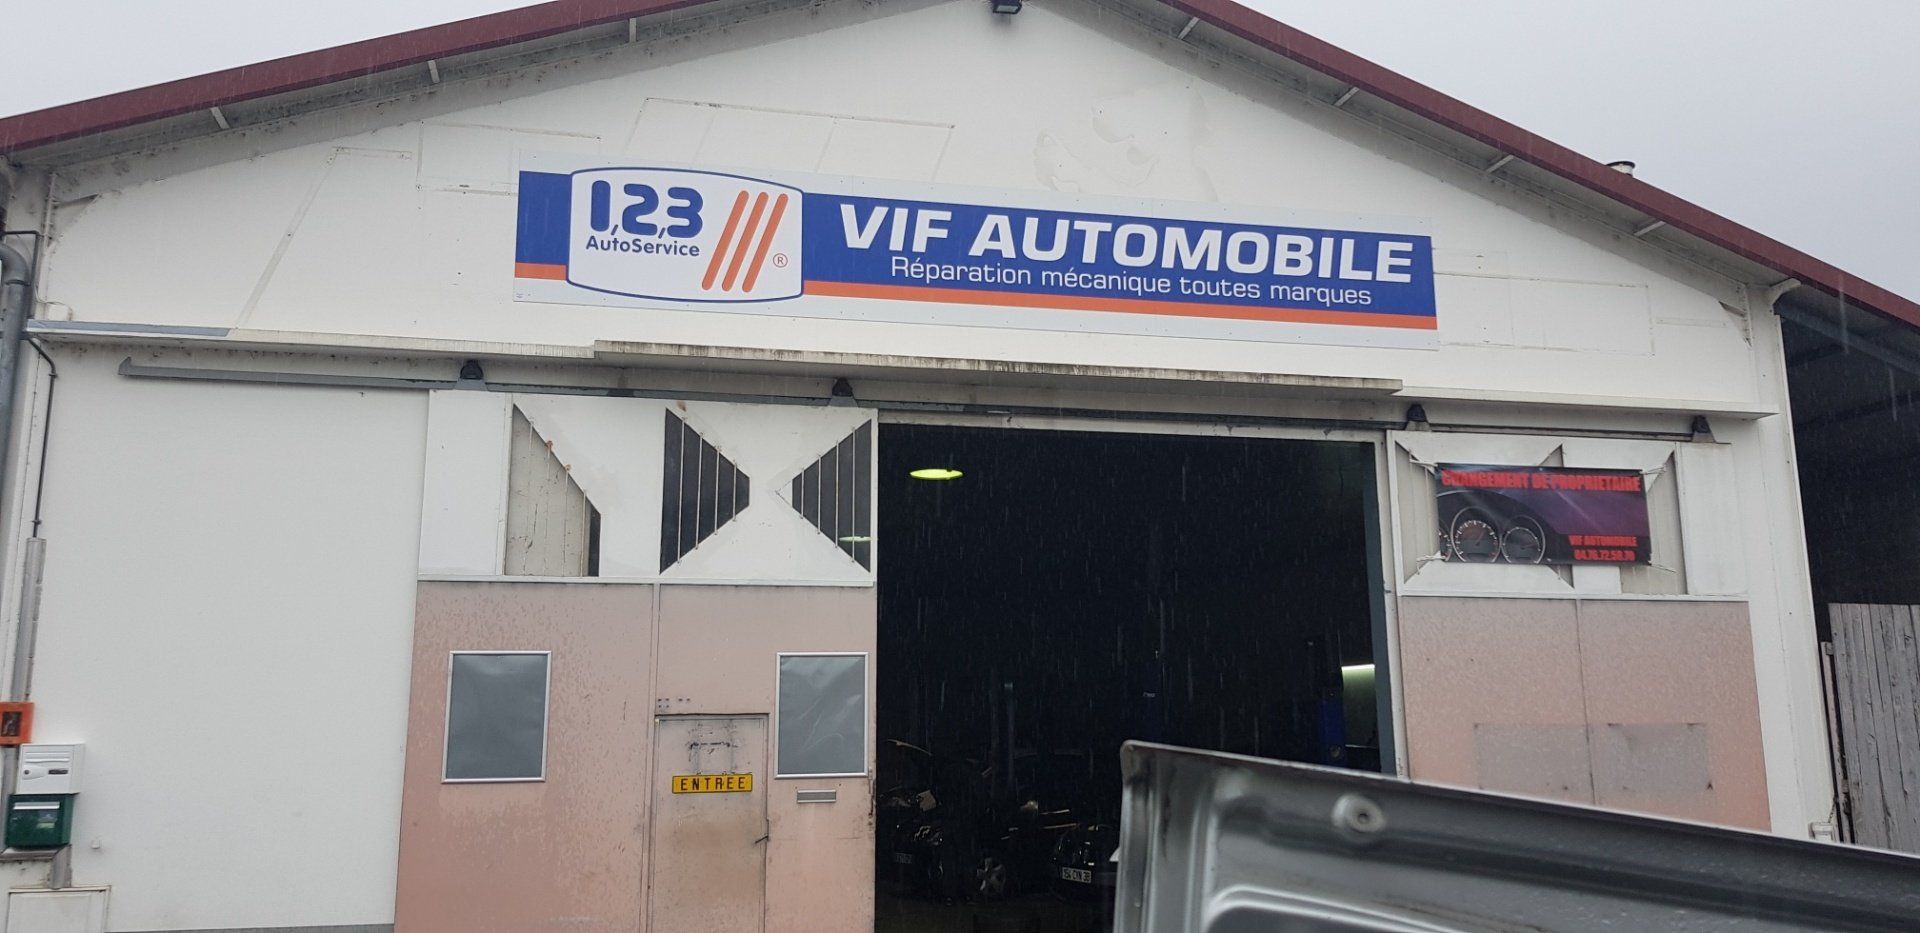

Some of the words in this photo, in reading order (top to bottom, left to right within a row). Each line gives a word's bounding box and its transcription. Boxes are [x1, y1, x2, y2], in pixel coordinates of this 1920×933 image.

[585, 235, 700, 257] AutoService
[839, 203, 952, 253] VIF
[968, 213, 1414, 284] AUTOMOBILE
[891, 255, 1031, 285] Réparation
[1041, 268, 1171, 298] mécanique
[1179, 276, 1261, 299] toutes
[1270, 285, 1372, 307] marques
[1441, 470, 1529, 488] CHANGEMENT
[1532, 473, 1549, 489] DE
[1568, 534, 1583, 547] VIF
[1583, 534, 1638, 547] AUTOMOBILE
[680, 776, 746, 791] ENTREE
